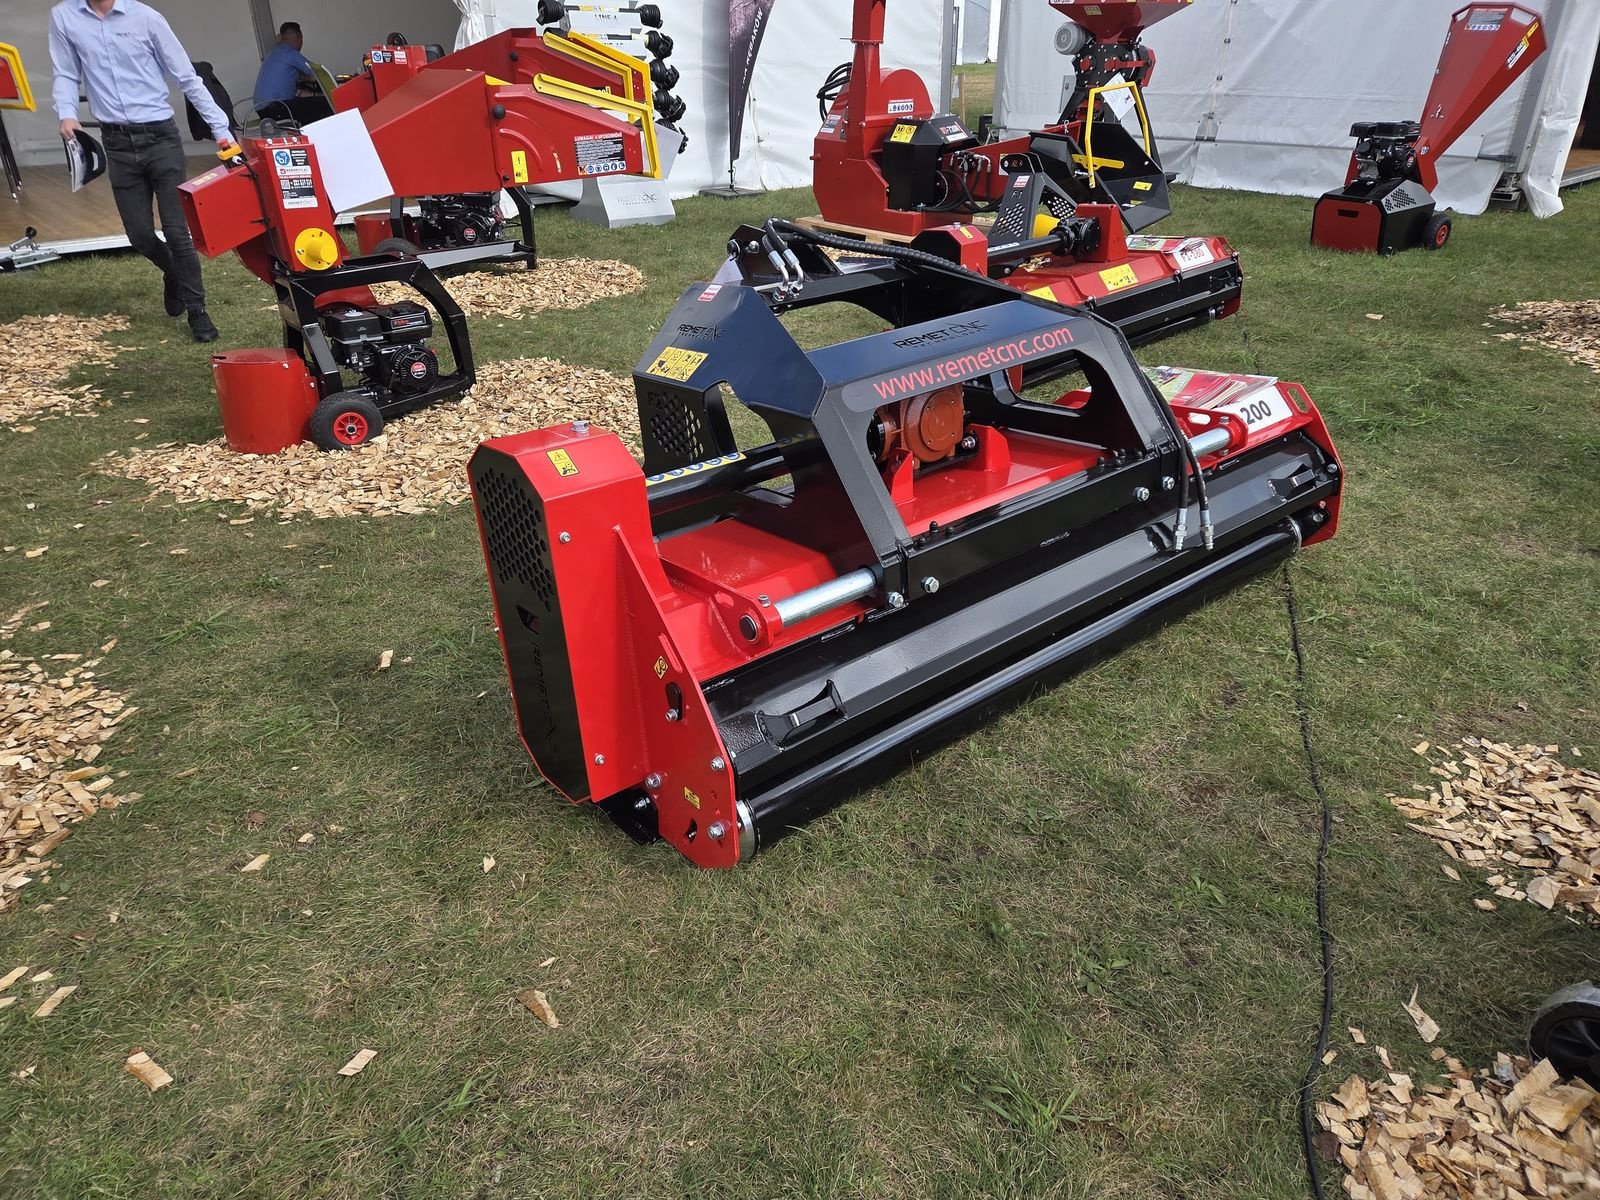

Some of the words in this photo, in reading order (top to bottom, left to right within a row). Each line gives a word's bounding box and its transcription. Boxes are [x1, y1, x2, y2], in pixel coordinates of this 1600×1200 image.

[1180, 247, 1205, 262] F1-180
[677, 324, 708, 335] REMET
[893, 330, 950, 348] REMET
[949, 320, 988, 333] CNC
[873, 327, 1074, 399] www.remetcnc.com
[1240, 400, 1272, 425] 200
